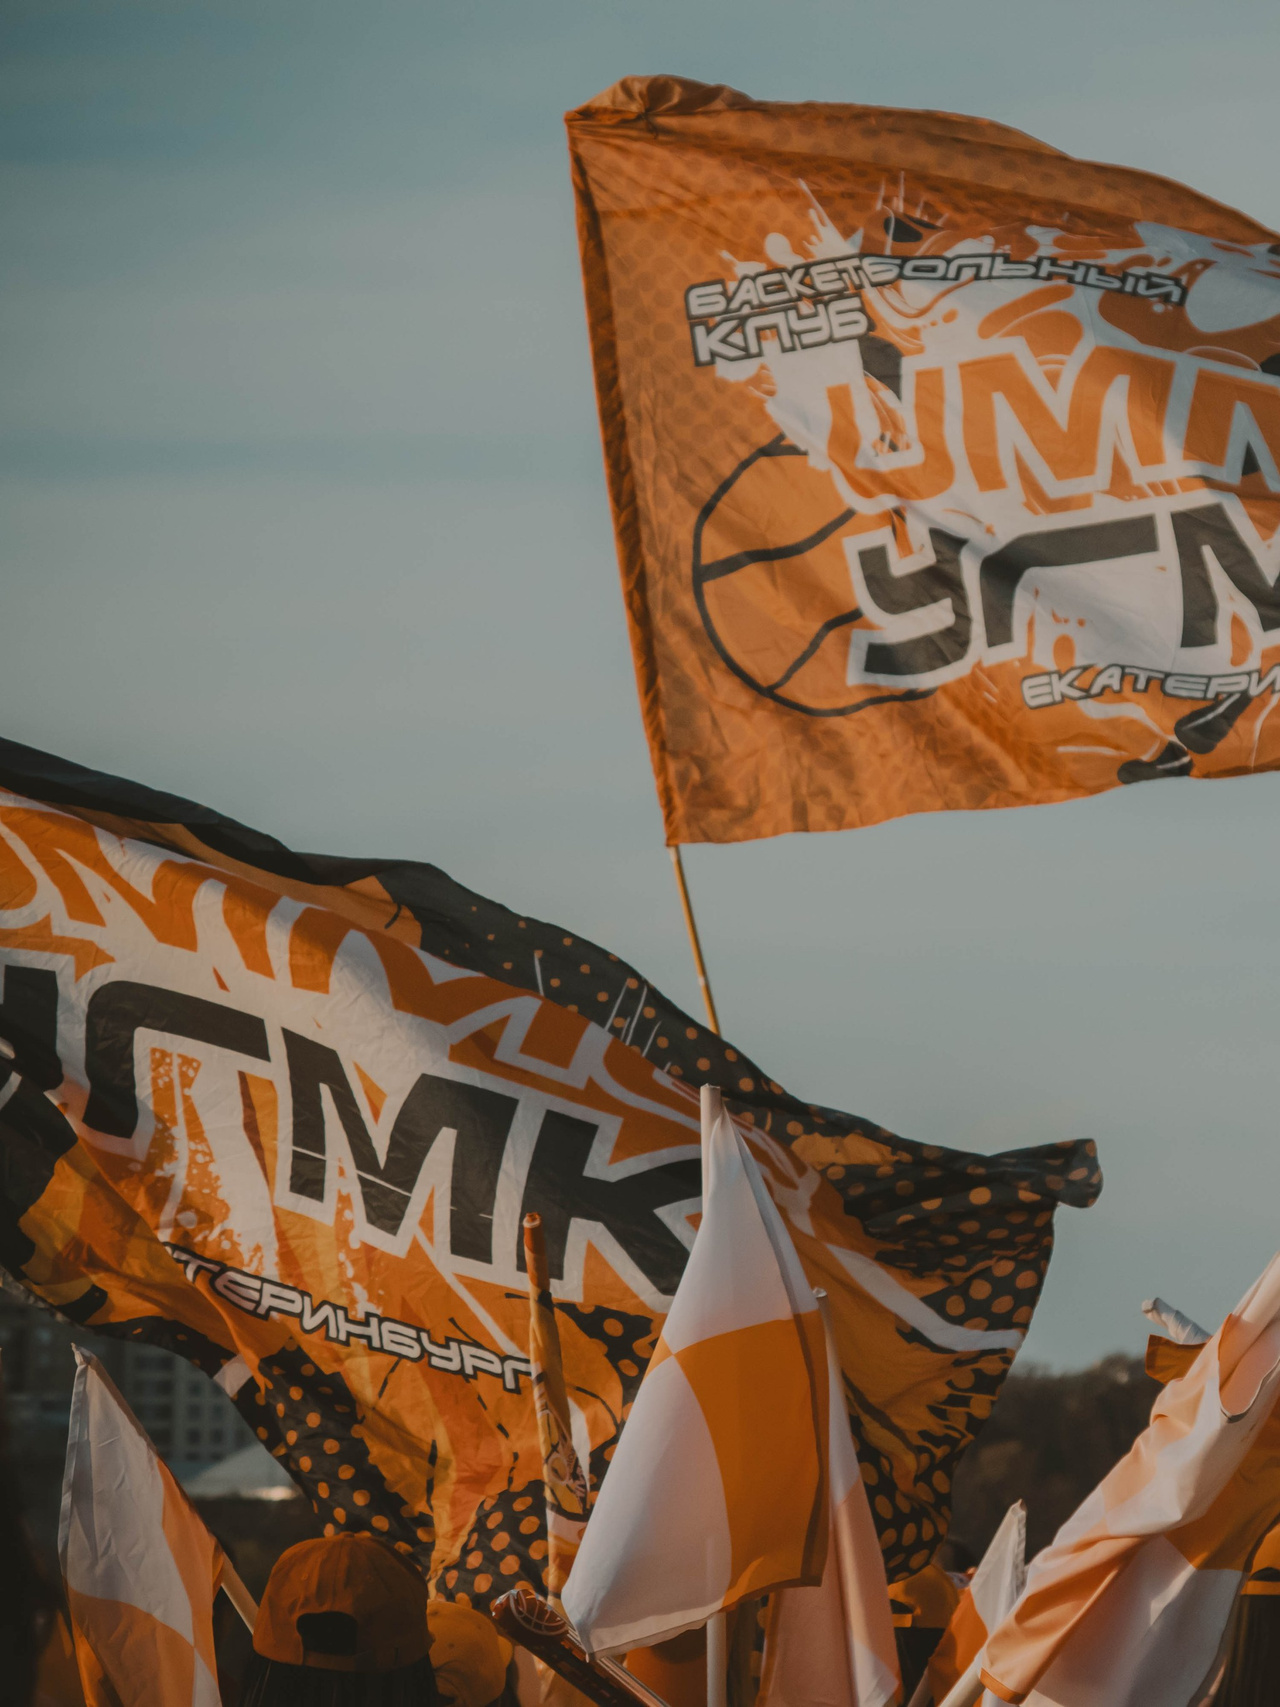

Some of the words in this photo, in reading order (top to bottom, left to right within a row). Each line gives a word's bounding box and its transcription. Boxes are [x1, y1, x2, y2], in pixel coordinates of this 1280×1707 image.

[687, 253, 1187, 318] БАСКЕТБОЛЬНЫЙ
[692, 296, 873, 366] КЛУБ
[166, 1243, 537, 1394] ТЕРИНБУРГ
